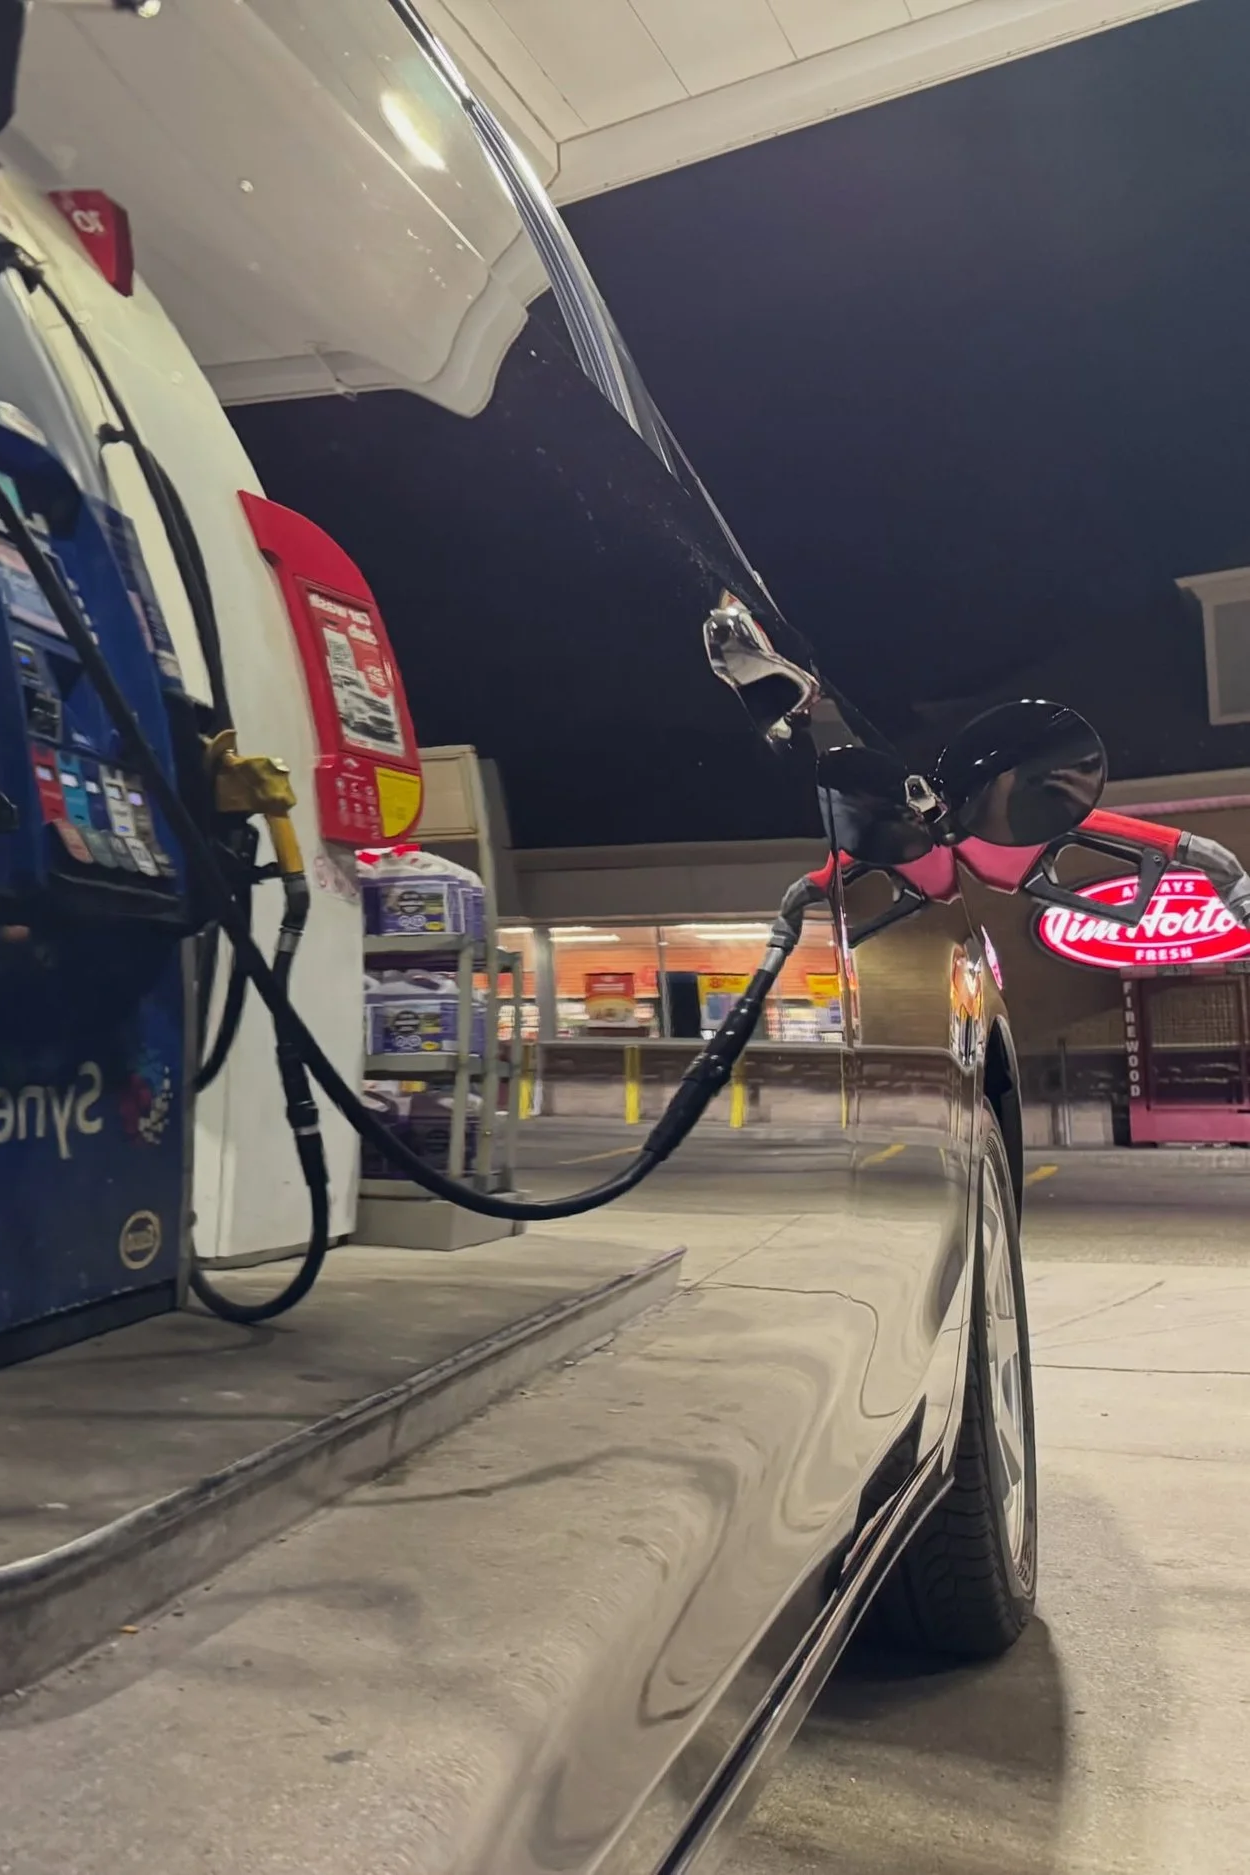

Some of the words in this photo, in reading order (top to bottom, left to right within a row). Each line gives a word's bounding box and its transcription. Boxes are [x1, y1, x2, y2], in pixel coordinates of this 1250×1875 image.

[1121, 881, 1195, 898] AAYS
[1044, 906, 1121, 944] Tim
[1125, 896, 1241, 940] Horto
[1135, 947, 1193, 961] FRESH
[1123, 981, 1141, 1097] FIREWOOD
